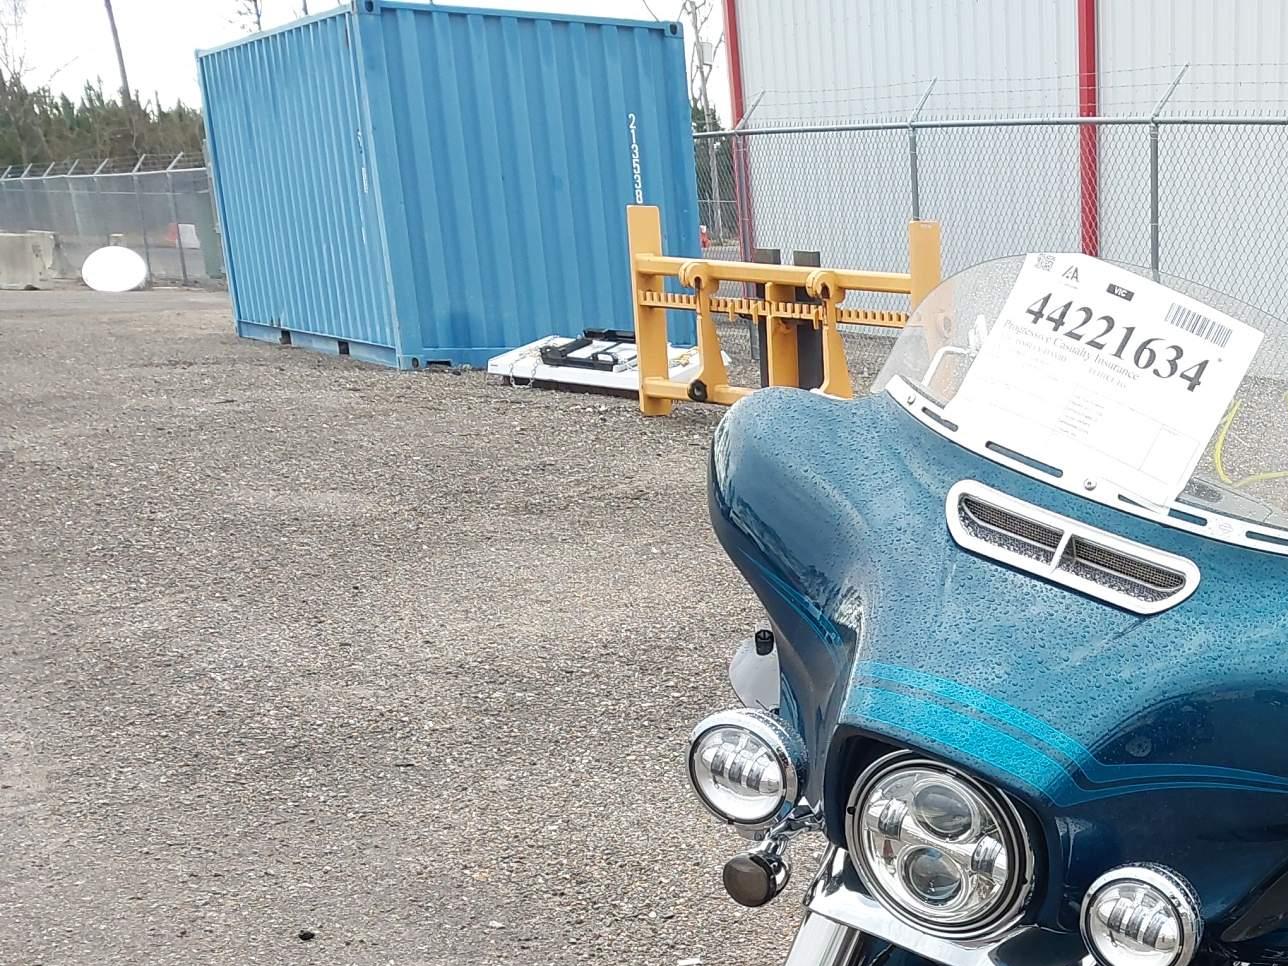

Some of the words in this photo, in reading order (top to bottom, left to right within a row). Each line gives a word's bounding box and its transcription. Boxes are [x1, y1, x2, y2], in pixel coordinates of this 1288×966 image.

[1025, 292, 1211, 393] 44221634
[1053, 337, 1092, 362] Casualty
[1094, 352, 1141, 381] Insurance
